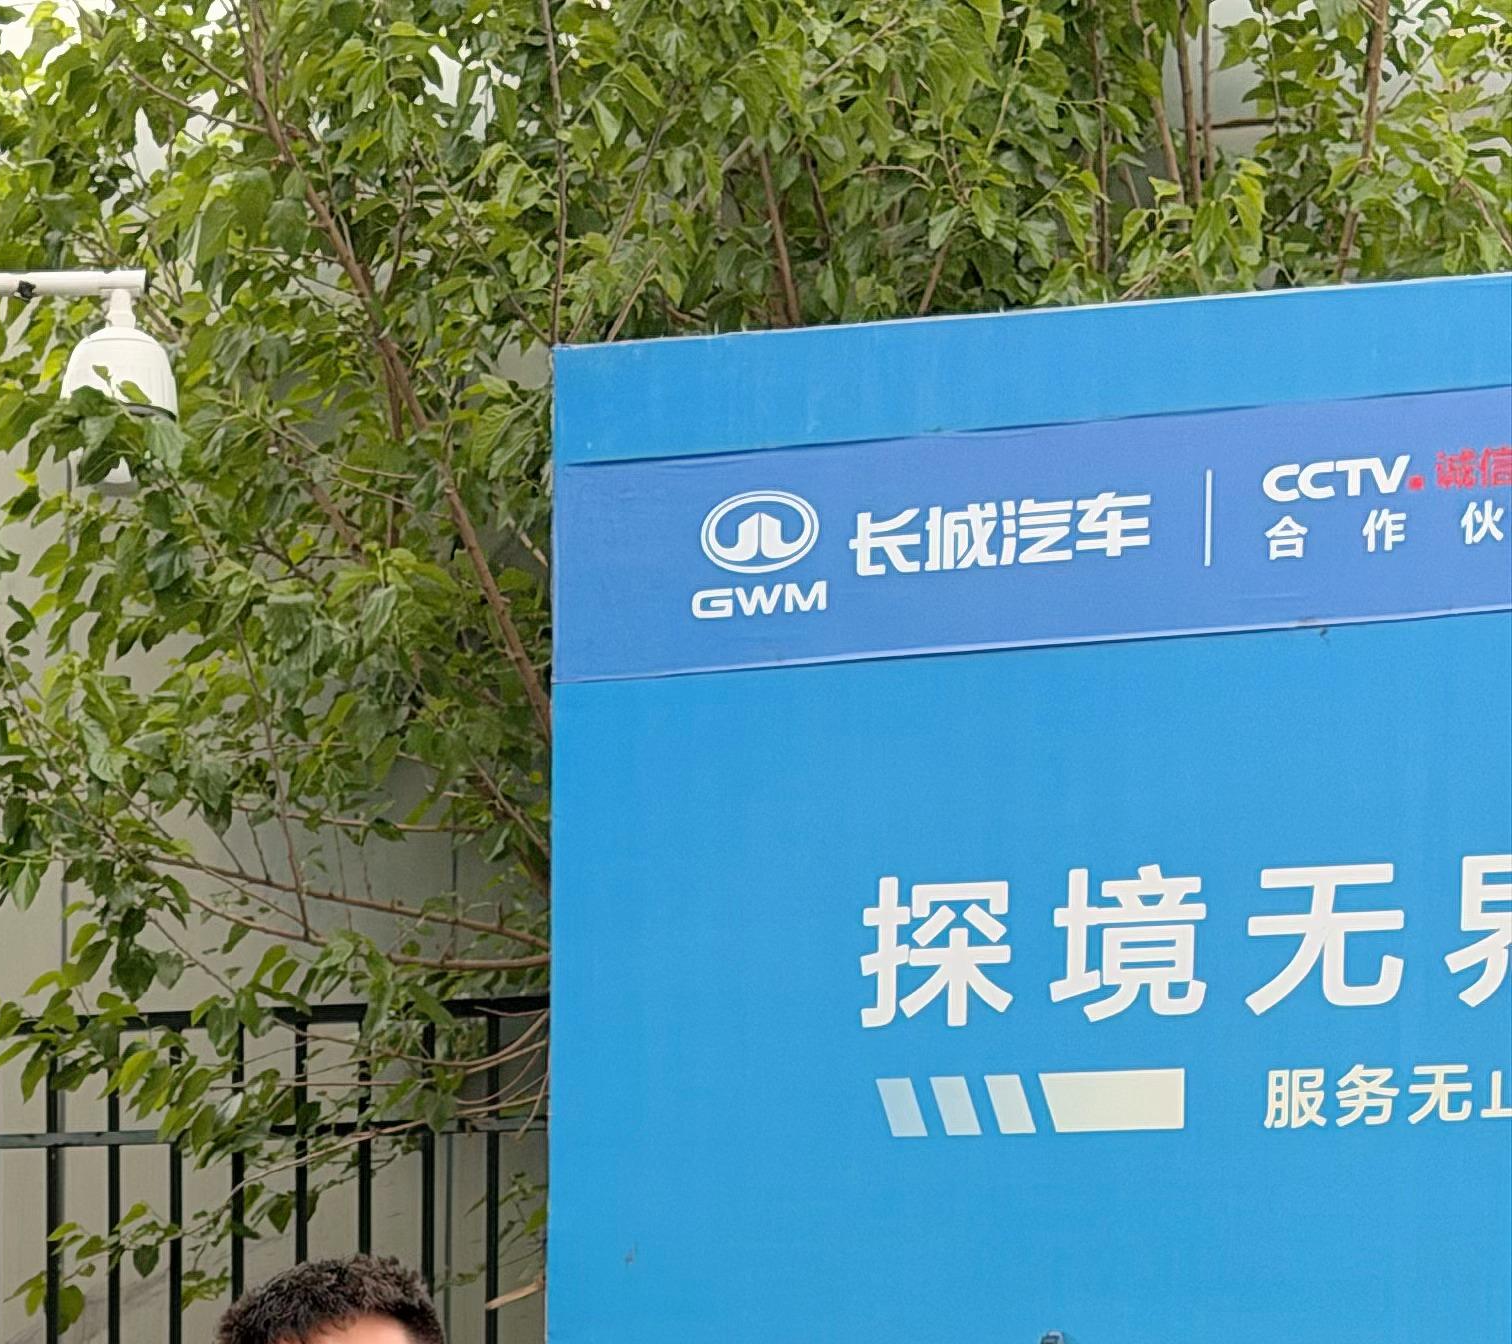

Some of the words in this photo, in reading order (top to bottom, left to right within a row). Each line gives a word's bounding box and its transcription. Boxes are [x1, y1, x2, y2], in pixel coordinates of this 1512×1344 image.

[849, 492, 1152, 577] 长城汽车
[691, 580, 827, 619] GWM
